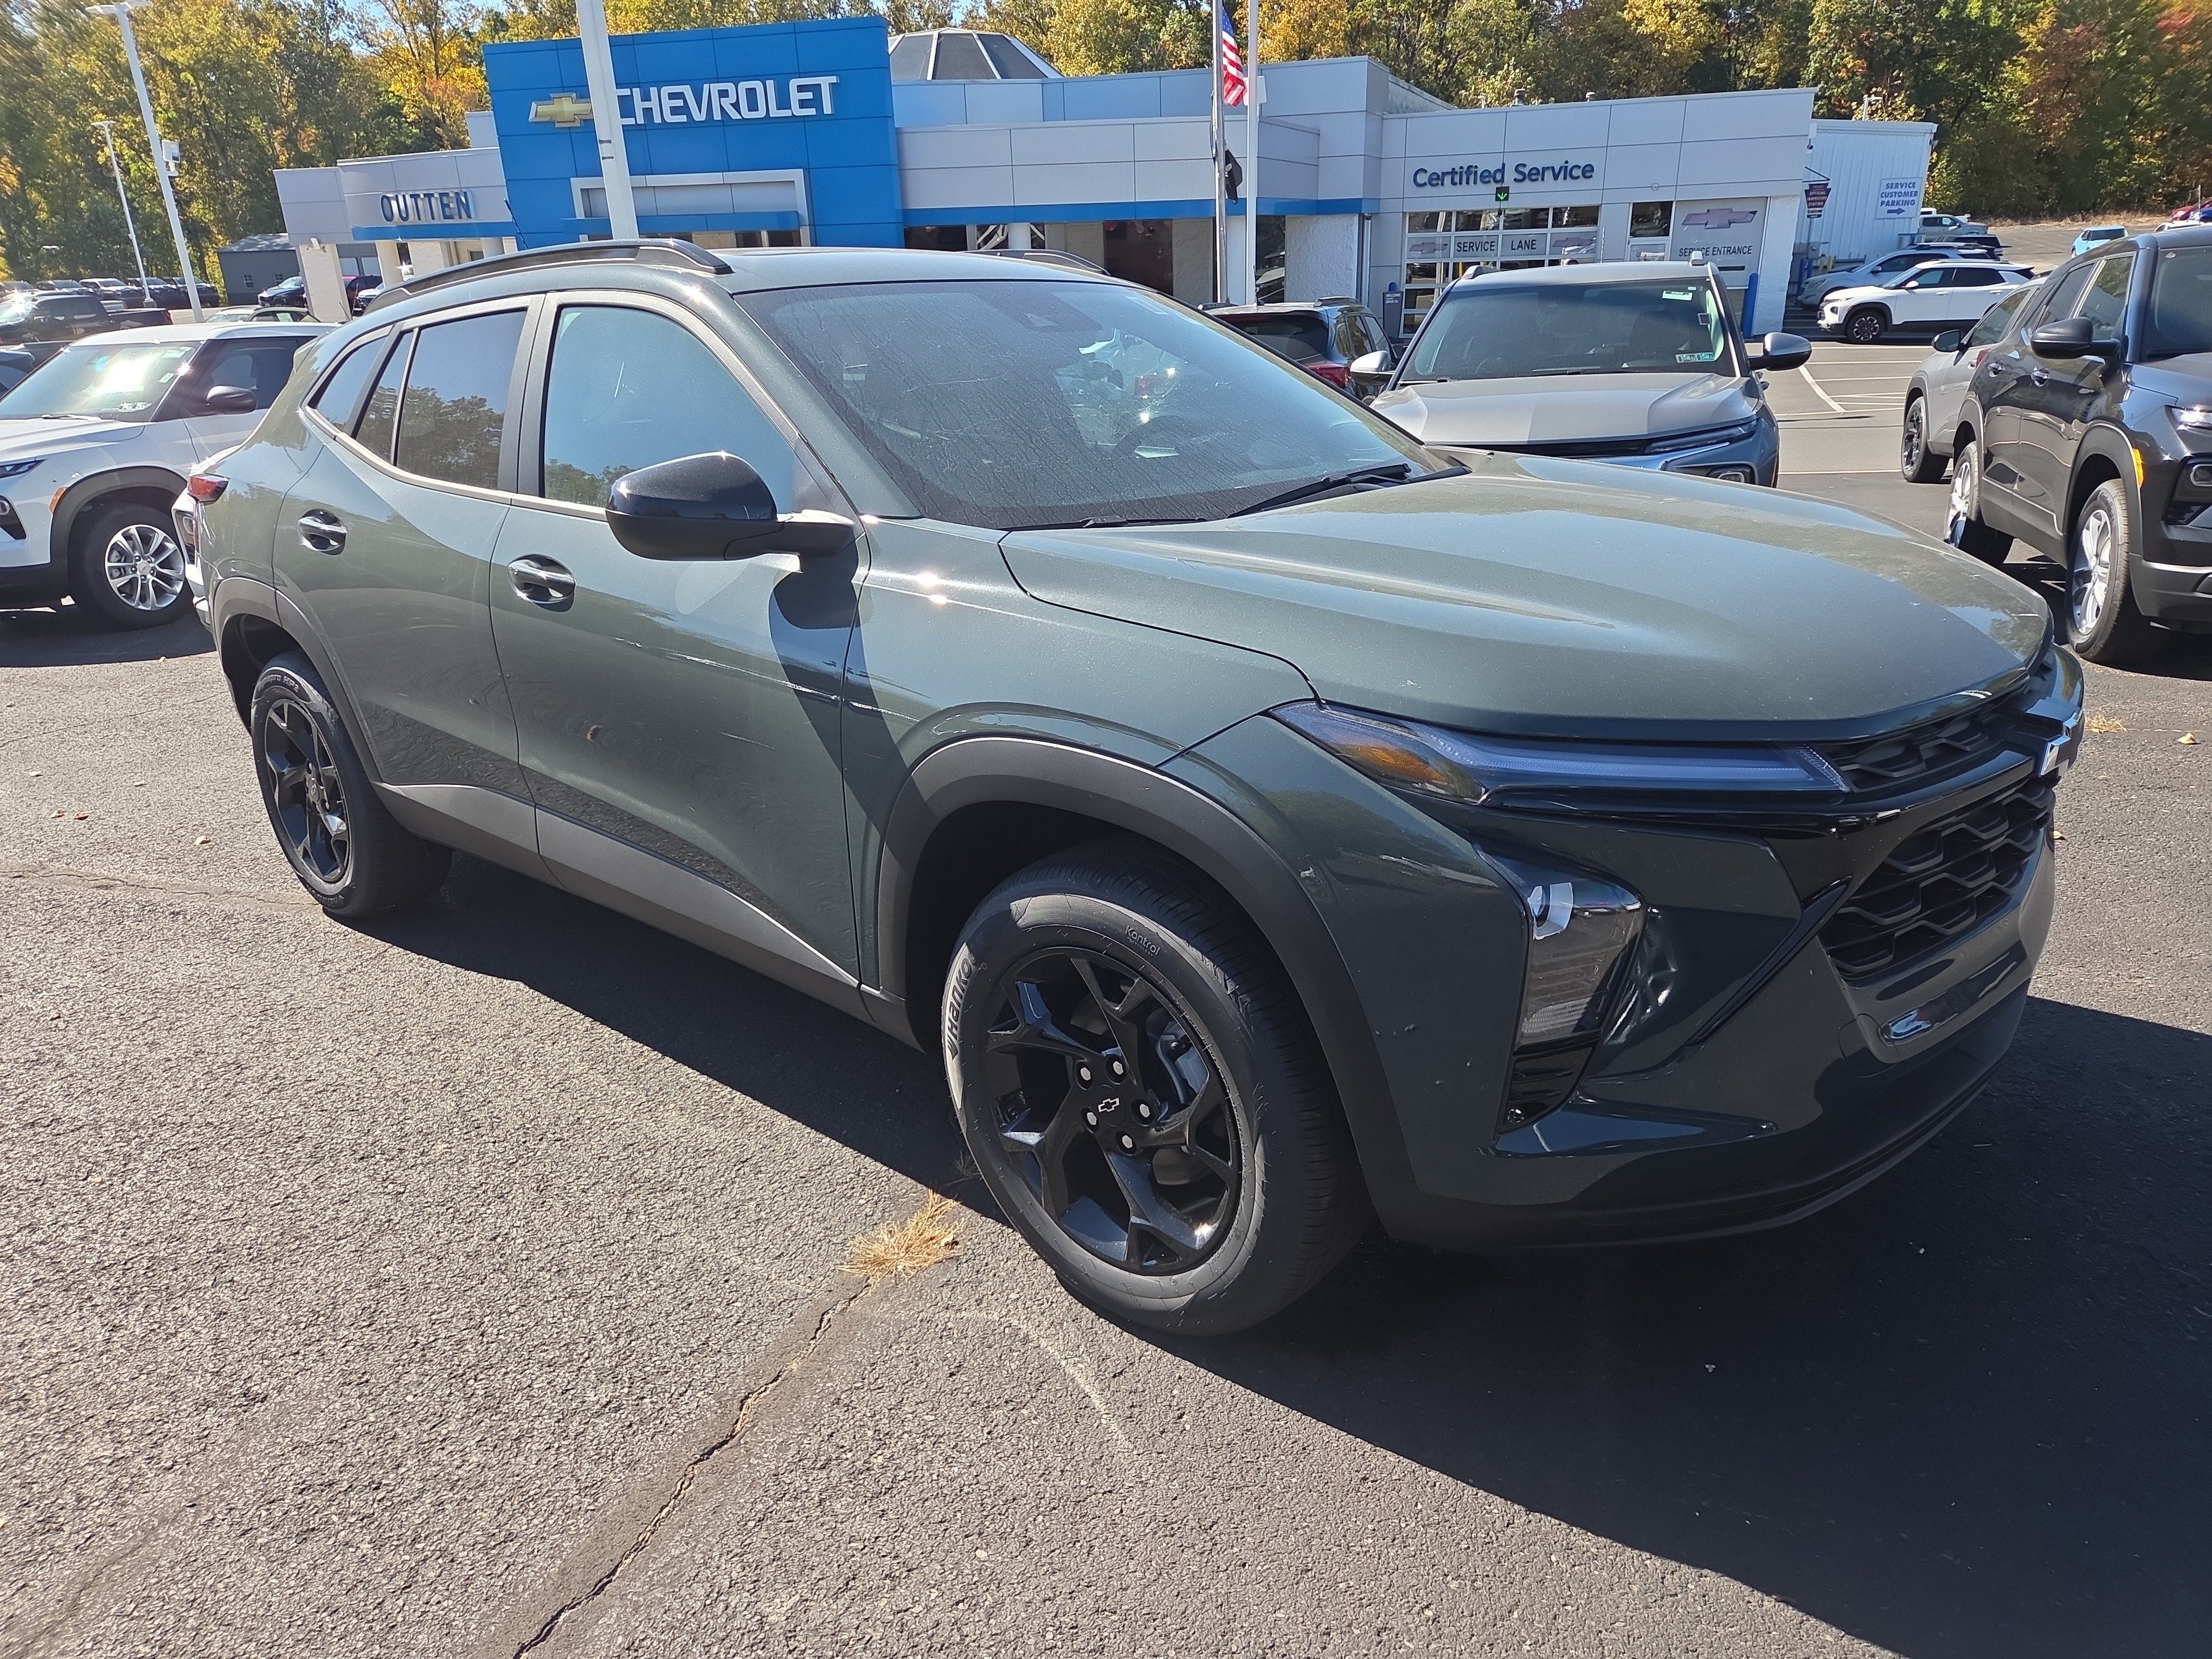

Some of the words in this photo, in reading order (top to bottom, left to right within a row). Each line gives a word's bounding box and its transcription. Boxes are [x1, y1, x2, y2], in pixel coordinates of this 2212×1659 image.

[616, 75, 839, 125] CHEVROLET
[1413, 163, 1506, 187] Certified
[1513, 160, 1594, 183] Service
[1886, 182, 1917, 190] SERVICE
[381, 191, 474, 222] OUTTEN
[1880, 190, 1919, 198] CUSTOMER
[1457, 241, 1495, 253] SERVICE
[1510, 239, 1537, 250] LANE
[1712, 245, 1753, 256] ENTRANCE
[1124, 924, 1161, 956] Kontrol
[948, 956, 973, 1041] Hanko
